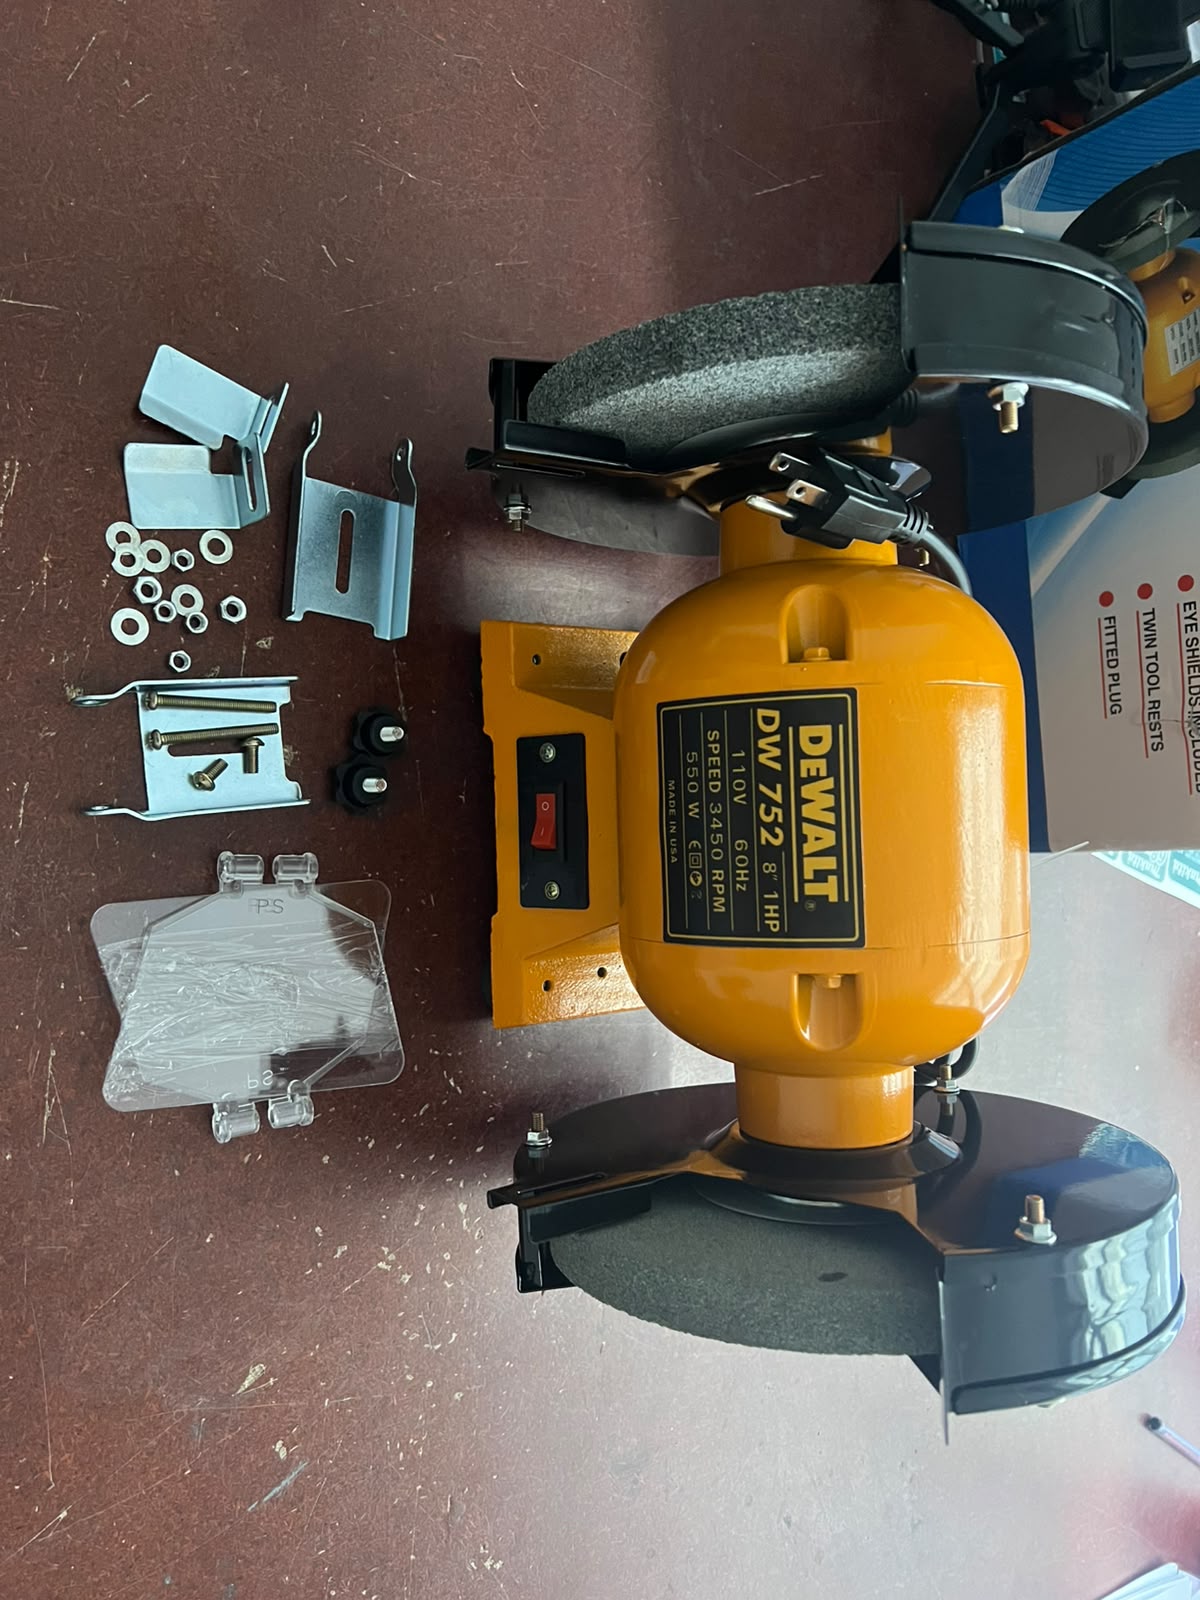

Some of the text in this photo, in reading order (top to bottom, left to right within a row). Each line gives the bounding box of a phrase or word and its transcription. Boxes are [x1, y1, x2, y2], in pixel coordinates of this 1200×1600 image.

[1182, 601, 1198, 634] EYE
[1104, 616, 1122, 715] FITTED PLUG
[1142, 608, 1164, 752] TWIN TOOL RESTS
[1185, 637, 1200, 706] SHIELDS
[757, 708, 782, 771] DW
[668, 780, 676, 816] MADE
[687, 752, 699, 819] 550 W
[758, 783, 784, 846] 752
[670, 821, 676, 832] IN
[708, 730, 726, 912] SPEED 3450 RPM
[732, 750, 748, 891] 110V 60Hz
